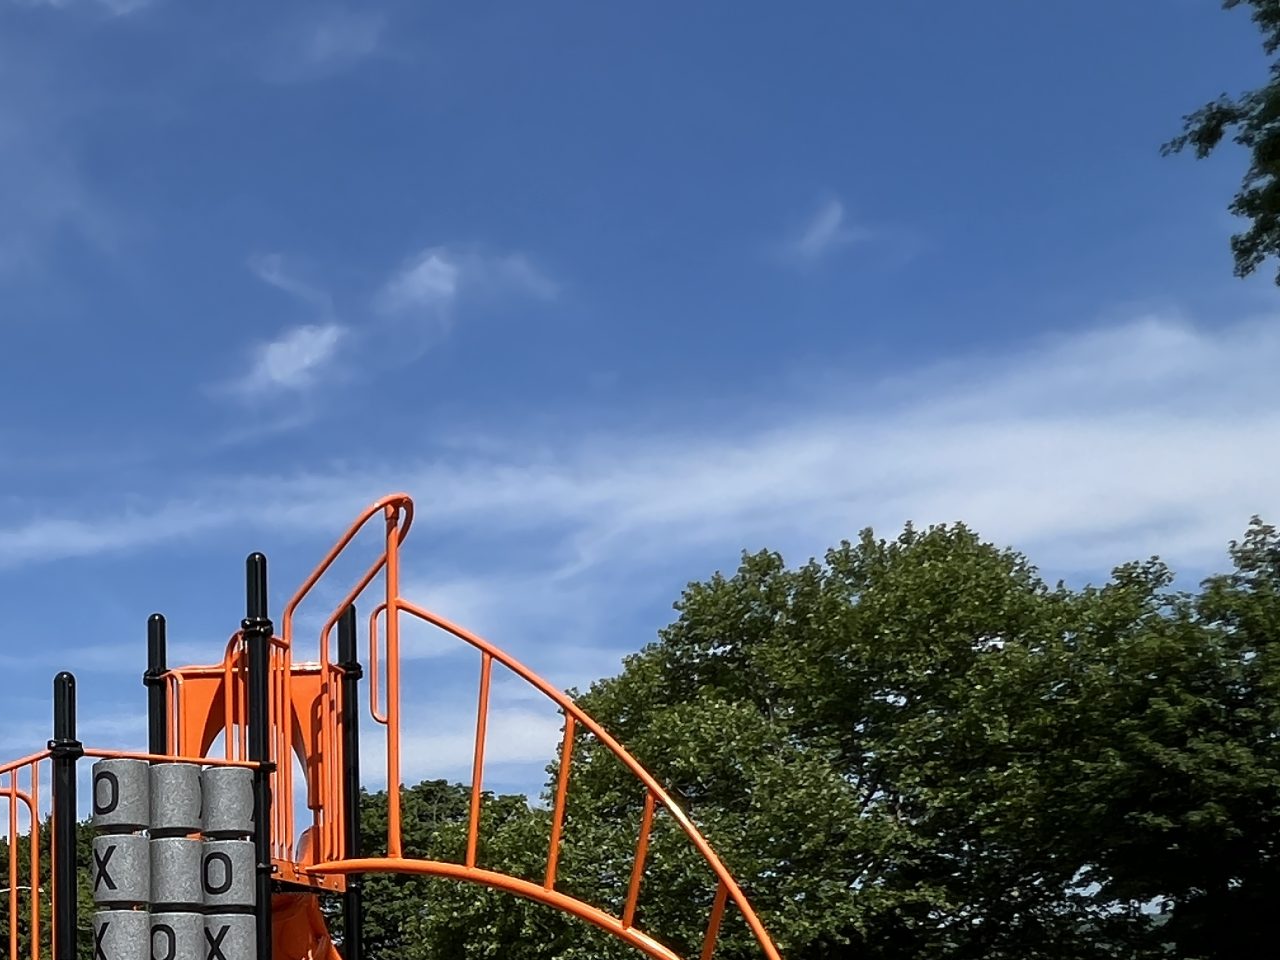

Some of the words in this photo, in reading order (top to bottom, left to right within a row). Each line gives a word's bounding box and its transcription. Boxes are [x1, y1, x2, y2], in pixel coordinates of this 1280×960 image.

[93, 771, 119, 815] O
[94, 846, 118, 891] X
[202, 852, 233, 895] O
